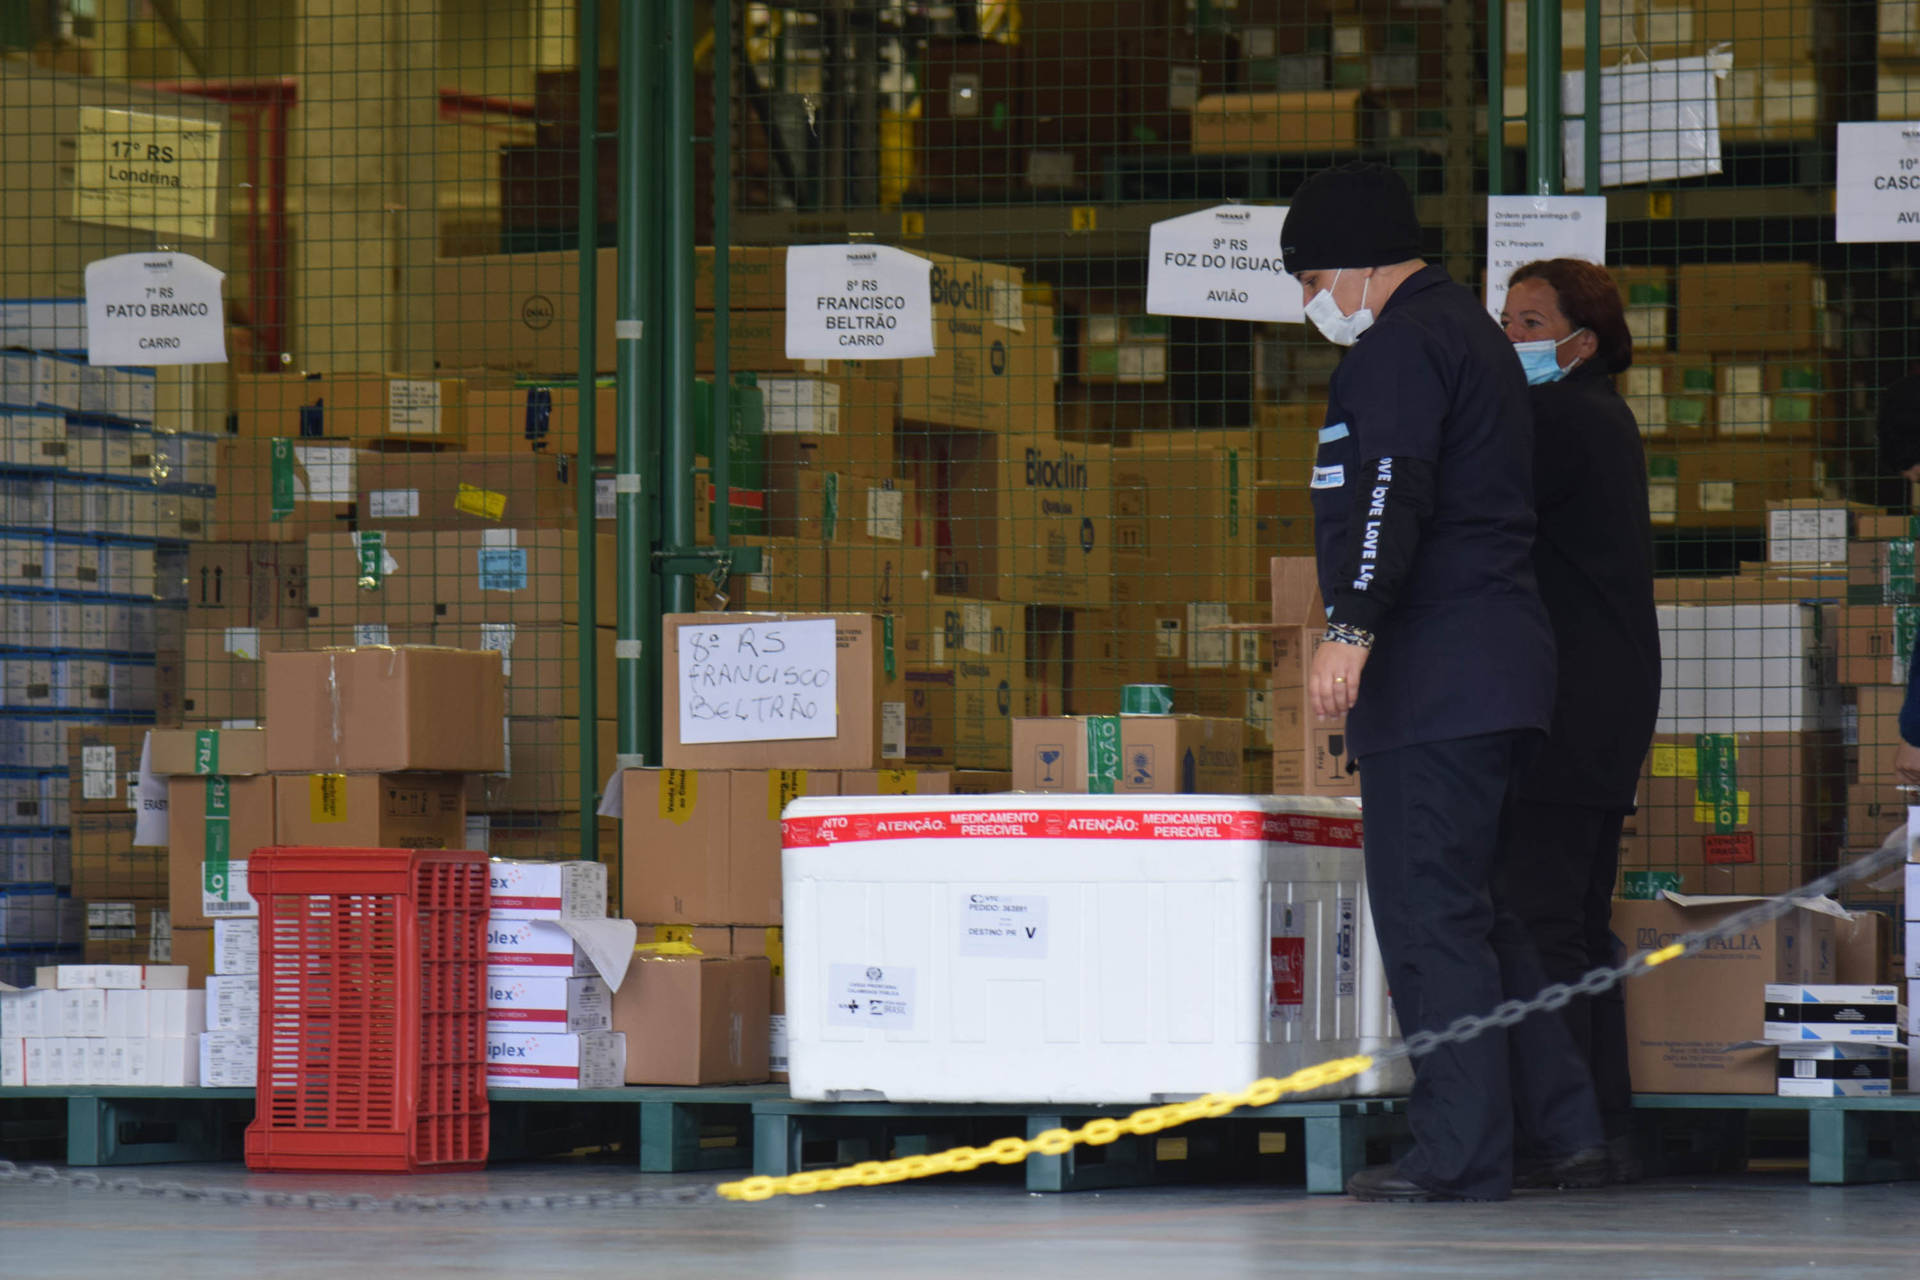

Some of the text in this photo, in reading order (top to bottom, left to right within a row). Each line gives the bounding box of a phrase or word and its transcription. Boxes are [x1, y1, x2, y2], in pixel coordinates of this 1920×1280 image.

[147, 144, 174, 163] RS
[108, 166, 180, 189] Londrina
[1874, 175, 1920, 190] CASC
[1897, 211, 1920, 224] AVI
[1230, 239, 1248, 251] RS
[1164, 252, 1284, 275] FOZ DO IGUAÇ
[159, 287, 174, 299] RS
[862, 280, 878, 291] RS
[817, 296, 905, 310] FRANCISCO
[1207, 289, 1249, 303] AVIÃO
[106, 302, 208, 318] PATO BRANCO
[826, 313, 897, 329] BELTRÃO
[139, 337, 180, 349] CARRO
[839, 334, 884, 346] CARRO
[1025, 447, 1088, 489] Bioclin
[1361, 520, 1382, 560] LOVE
[737, 627, 785, 658] RS
[688, 663, 831, 695] FRANCISCO
[689, 692, 818, 722] BELTRÃO
[199, 737, 212, 774] FRA
[1100, 721, 1117, 780] AÇÃO
[950, 812, 1040, 825] MEDICAMENTO
[1067, 816, 1140, 834] ATENÇÃO:
[1143, 813, 1233, 825] MEDICAMENTO
[490, 877, 509, 889] ex
[1025, 926, 1036, 939] V
[489, 986, 513, 1001] lex
